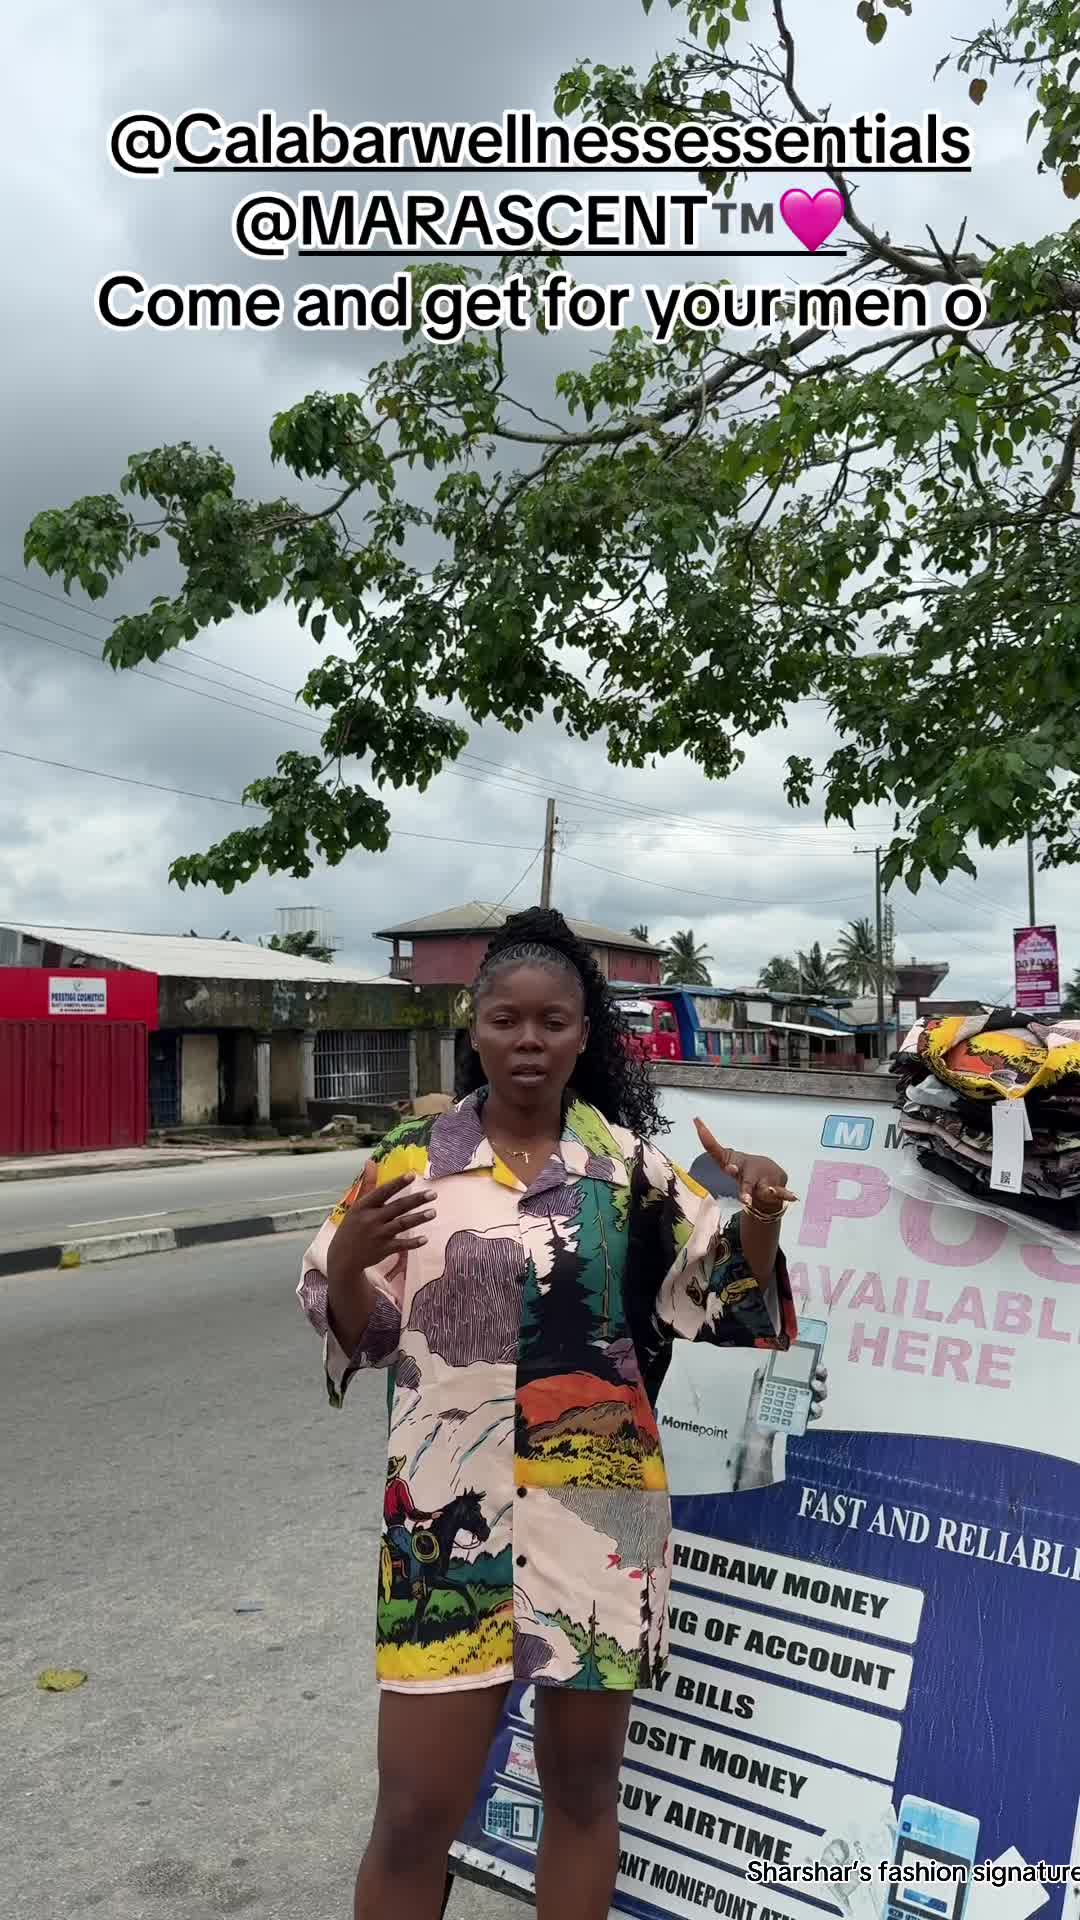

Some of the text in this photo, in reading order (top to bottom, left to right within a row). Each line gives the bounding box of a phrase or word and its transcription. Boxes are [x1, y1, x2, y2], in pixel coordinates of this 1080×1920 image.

[788, 1262, 1080, 1345] AVAILABL
[848, 1322, 1016, 1390] HERE
[661, 1414, 729, 1440] Moniepoint
[797, 1486, 867, 1529] FAST
[867, 1503, 931, 1544] AND
[672, 1544, 890, 1619] HDRAW MONEY
[667, 1604, 896, 1691] NG OF ACCOUNT
[675, 1675, 756, 1720] BILLS
[627, 1721, 808, 1800] OSIT MONEY
[664, 1801, 792, 1866] AIRTIME
[616, 1849, 650, 1882] ANT
[650, 1864, 758, 1920] MONIEPOINT
